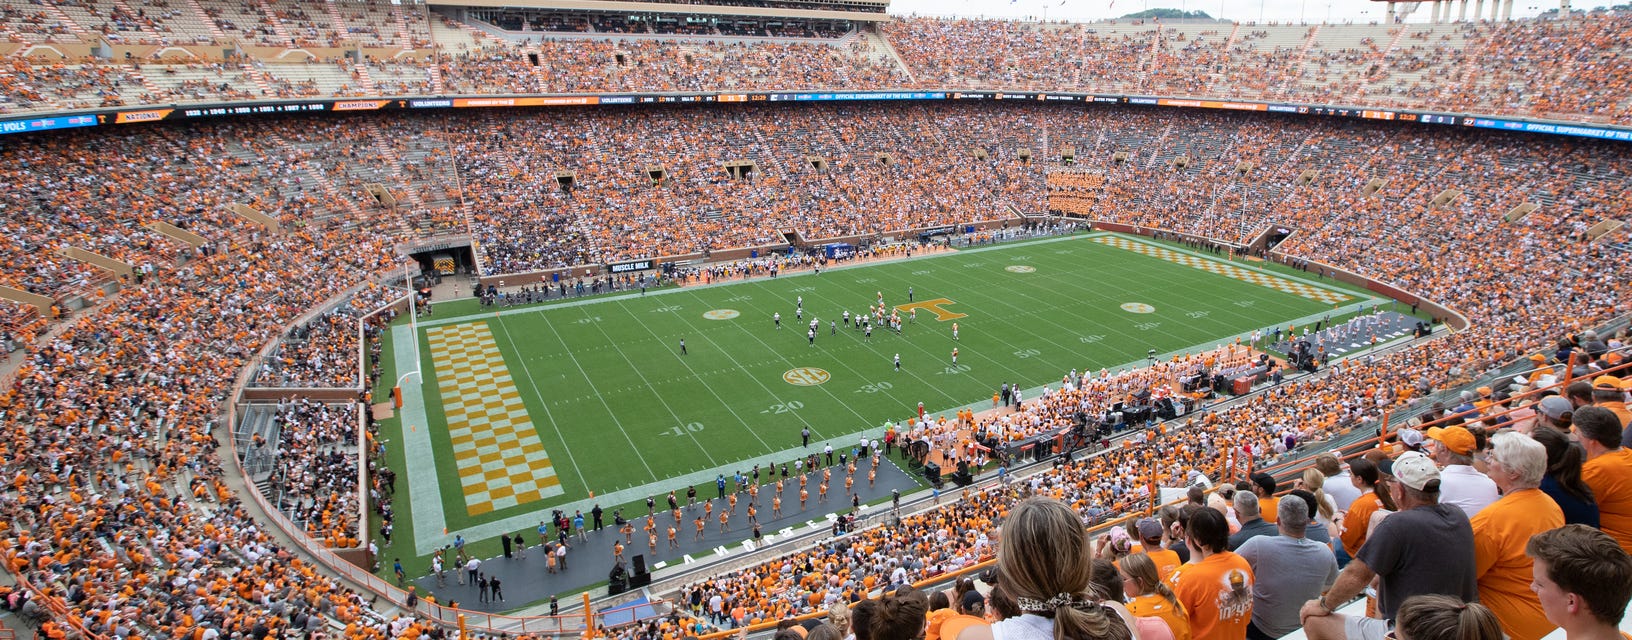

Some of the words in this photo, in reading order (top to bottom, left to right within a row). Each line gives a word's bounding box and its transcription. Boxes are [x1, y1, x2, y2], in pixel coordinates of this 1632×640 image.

[338, 101, 378, 110] CHAMPIONS
[412, 99, 452, 107] VOLUNTEERS
[125, 112, 160, 121] NATIONAL
[3, 121, 26, 132] VOLS
[1526, 123, 1556, 132] OFFICIAL
[1556, 126, 1606, 137] SUPERMARKET
[1616, 132, 1629, 140] THE
[612, 263, 634, 273] MUSCLE
[635, 261, 649, 270] MILK
[1013, 349, 1041, 358] 50
[786, 368, 829, 385] SEC
[863, 381, 893, 394] 30
[769, 400, 804, 415] 20
[669, 422, 704, 437] 10
